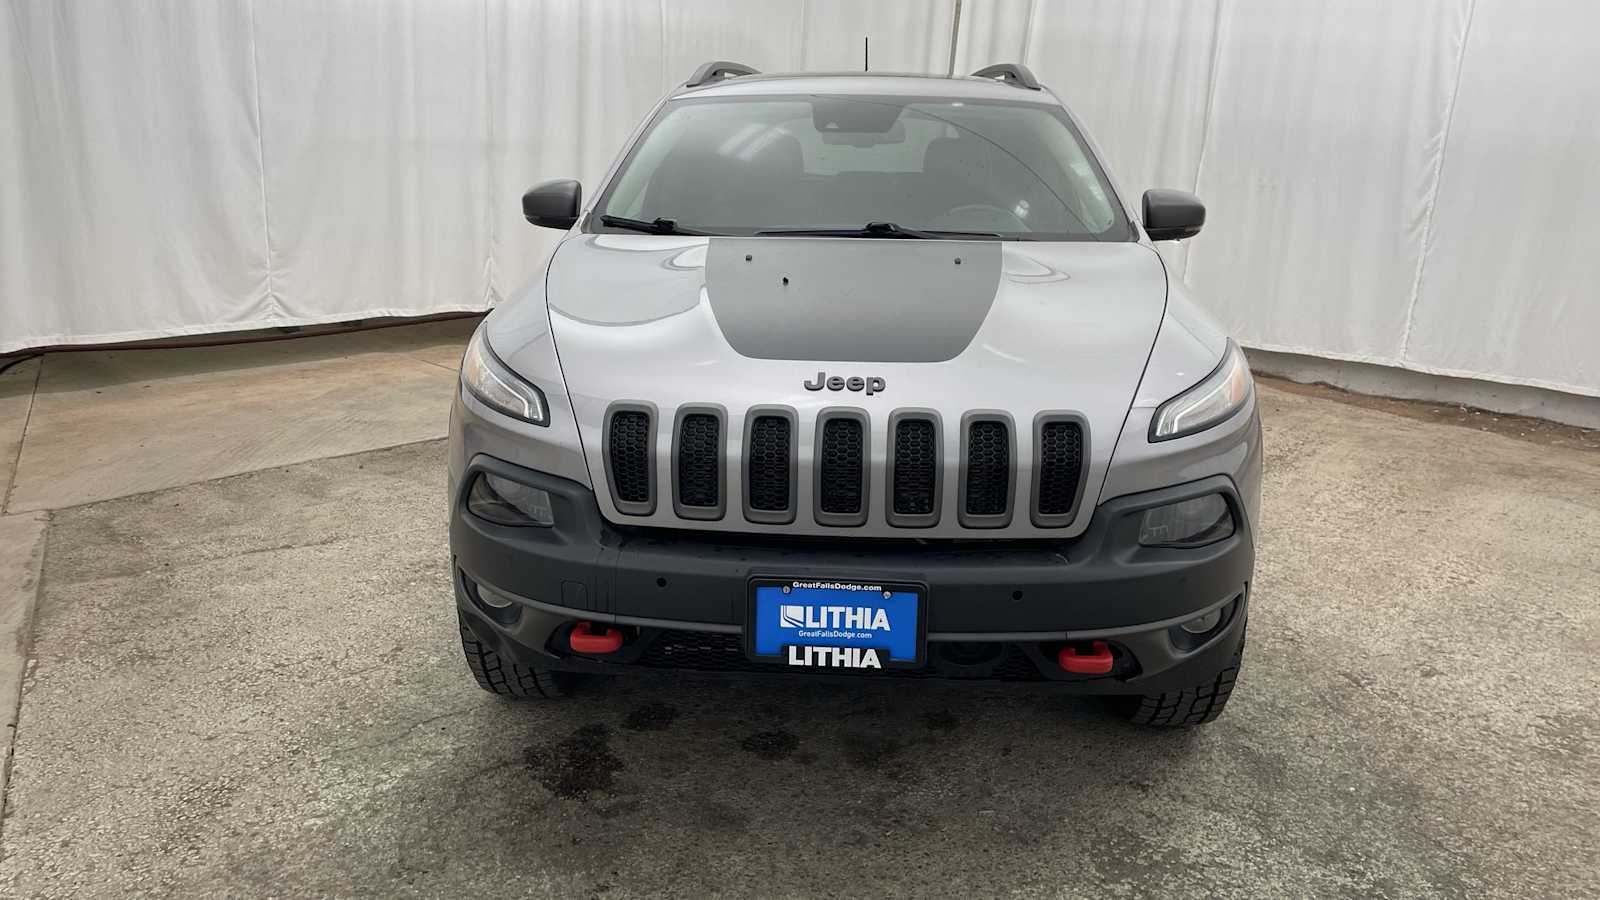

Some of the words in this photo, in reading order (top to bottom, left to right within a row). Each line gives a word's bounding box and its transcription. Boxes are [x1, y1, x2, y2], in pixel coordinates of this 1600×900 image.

[803, 372, 886, 396] Jeep
[792, 581, 882, 592] GreatFallsDodge.com
[805, 605, 891, 632] LITHIA
[798, 630, 873, 640] GreatFallsDodge.com
[788, 645, 882, 669] LITHIA
